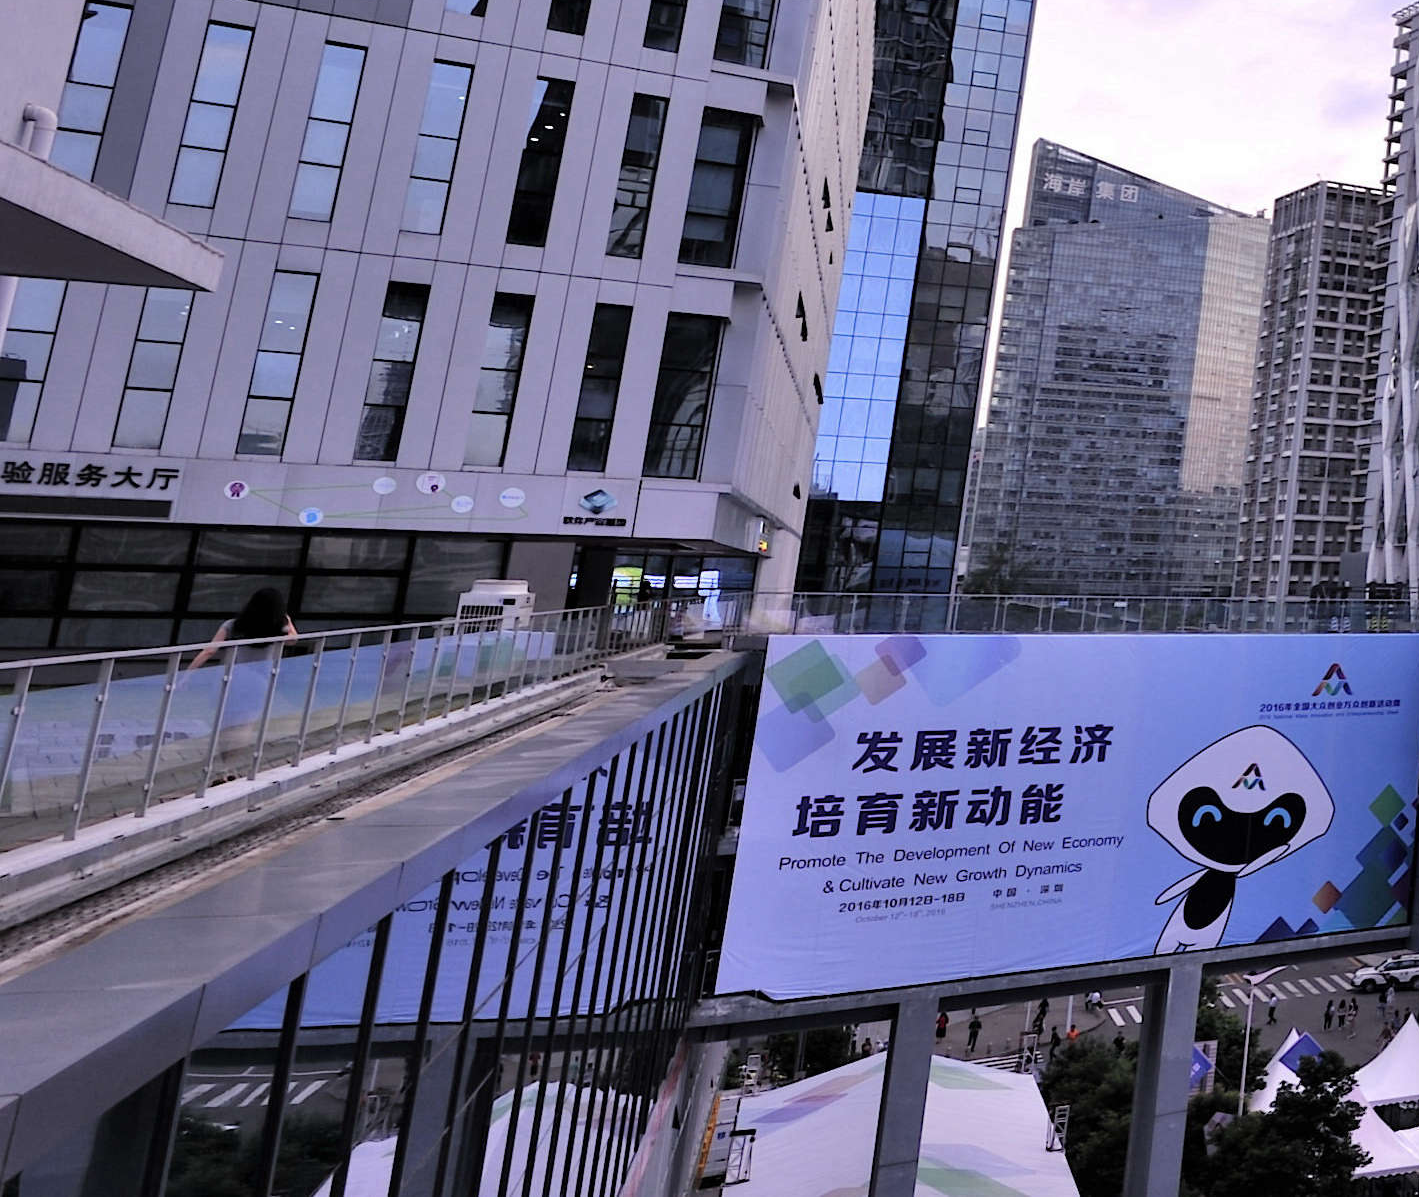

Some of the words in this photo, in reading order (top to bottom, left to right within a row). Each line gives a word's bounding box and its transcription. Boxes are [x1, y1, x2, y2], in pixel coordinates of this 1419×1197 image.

[1042, 172, 1140, 203] 海岸集团
[1, 461, 180, 490] 验服务大厅
[851, 723, 1115, 774] 发展新经济
[792, 783, 1065, 839] 培育新动能
[778, 853, 847, 871] Promote
[855, 850, 885, 865] The
[893, 843, 991, 863] Development
[998, 840, 1016, 854] Of
[1023, 839, 1055, 852] New
[1062, 834, 1125, 850] Economy
[822, 880, 834, 894] &
[839, 875, 905, 893] Cultivate
[914, 872, 948, 886] New
[956, 866, 1008, 883] Growth
[1016, 861, 1083, 880] Dynamics
